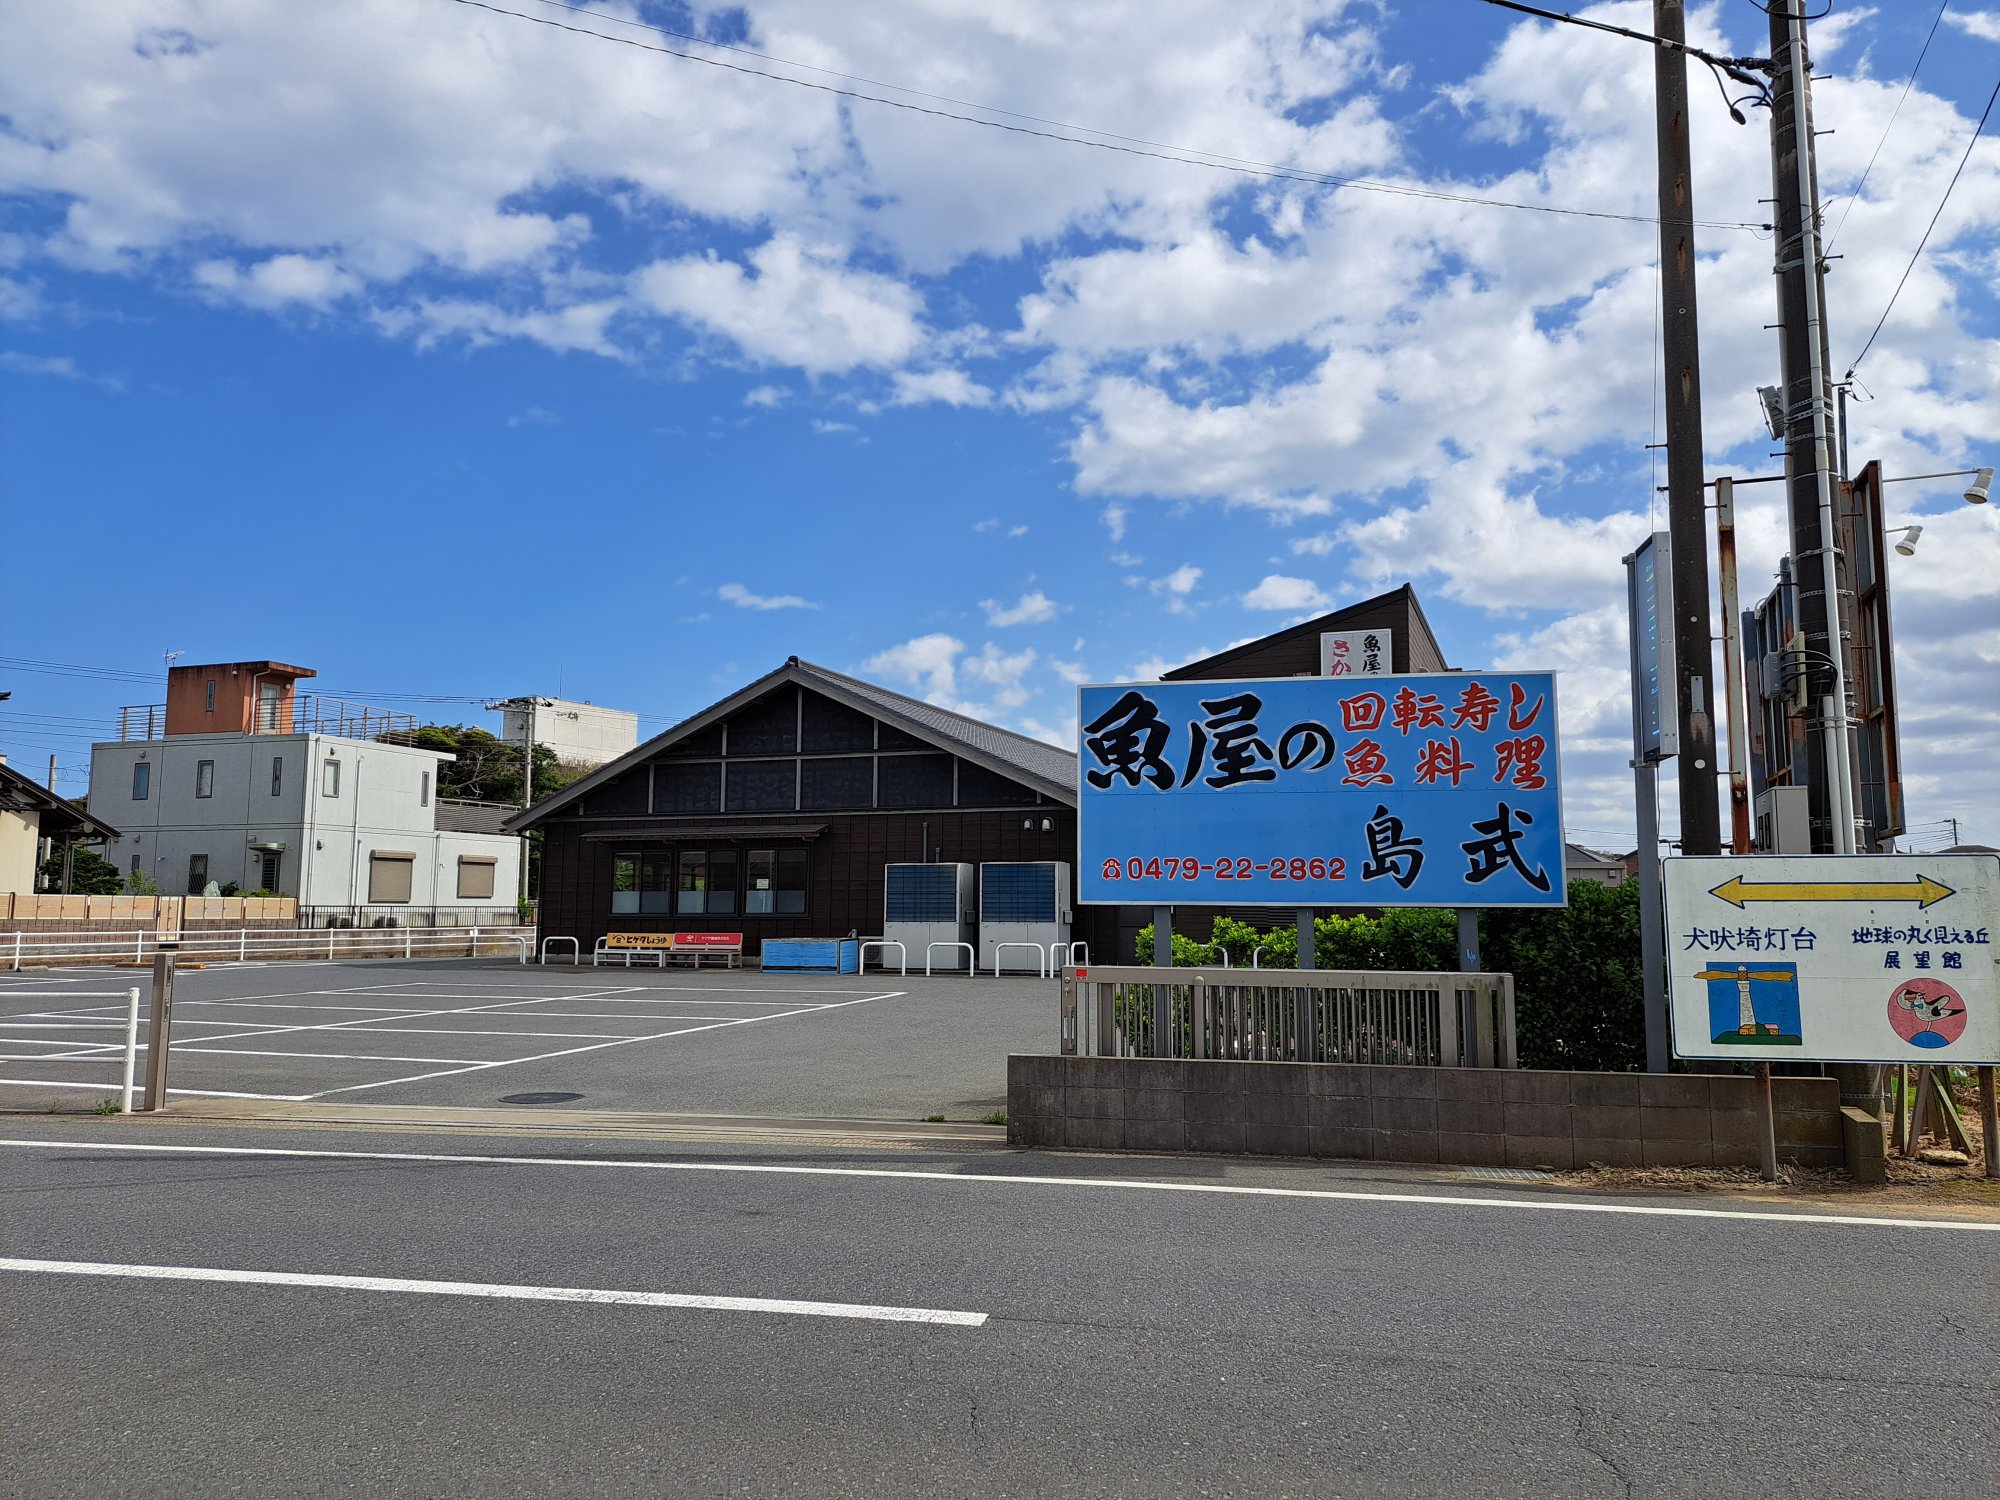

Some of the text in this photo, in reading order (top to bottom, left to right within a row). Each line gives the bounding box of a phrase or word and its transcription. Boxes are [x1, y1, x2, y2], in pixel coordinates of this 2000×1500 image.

[1338, 681, 1544, 736] 回転寿し
[1083, 690, 1336, 791] 魚屋の
[1340, 734, 1547, 790] 魚料理
[1361, 801, 1552, 892] 島武
[1127, 856, 1347, 881] 0479-22-2862
[626, 935, 668, 944] ヒゲタしょうゆ
[1682, 926, 1817, 951] 犬吠埼灯台
[1851, 925, 1990, 944] 地球の丸く見える丘
[1884, 950, 1962, 969] 展望館
